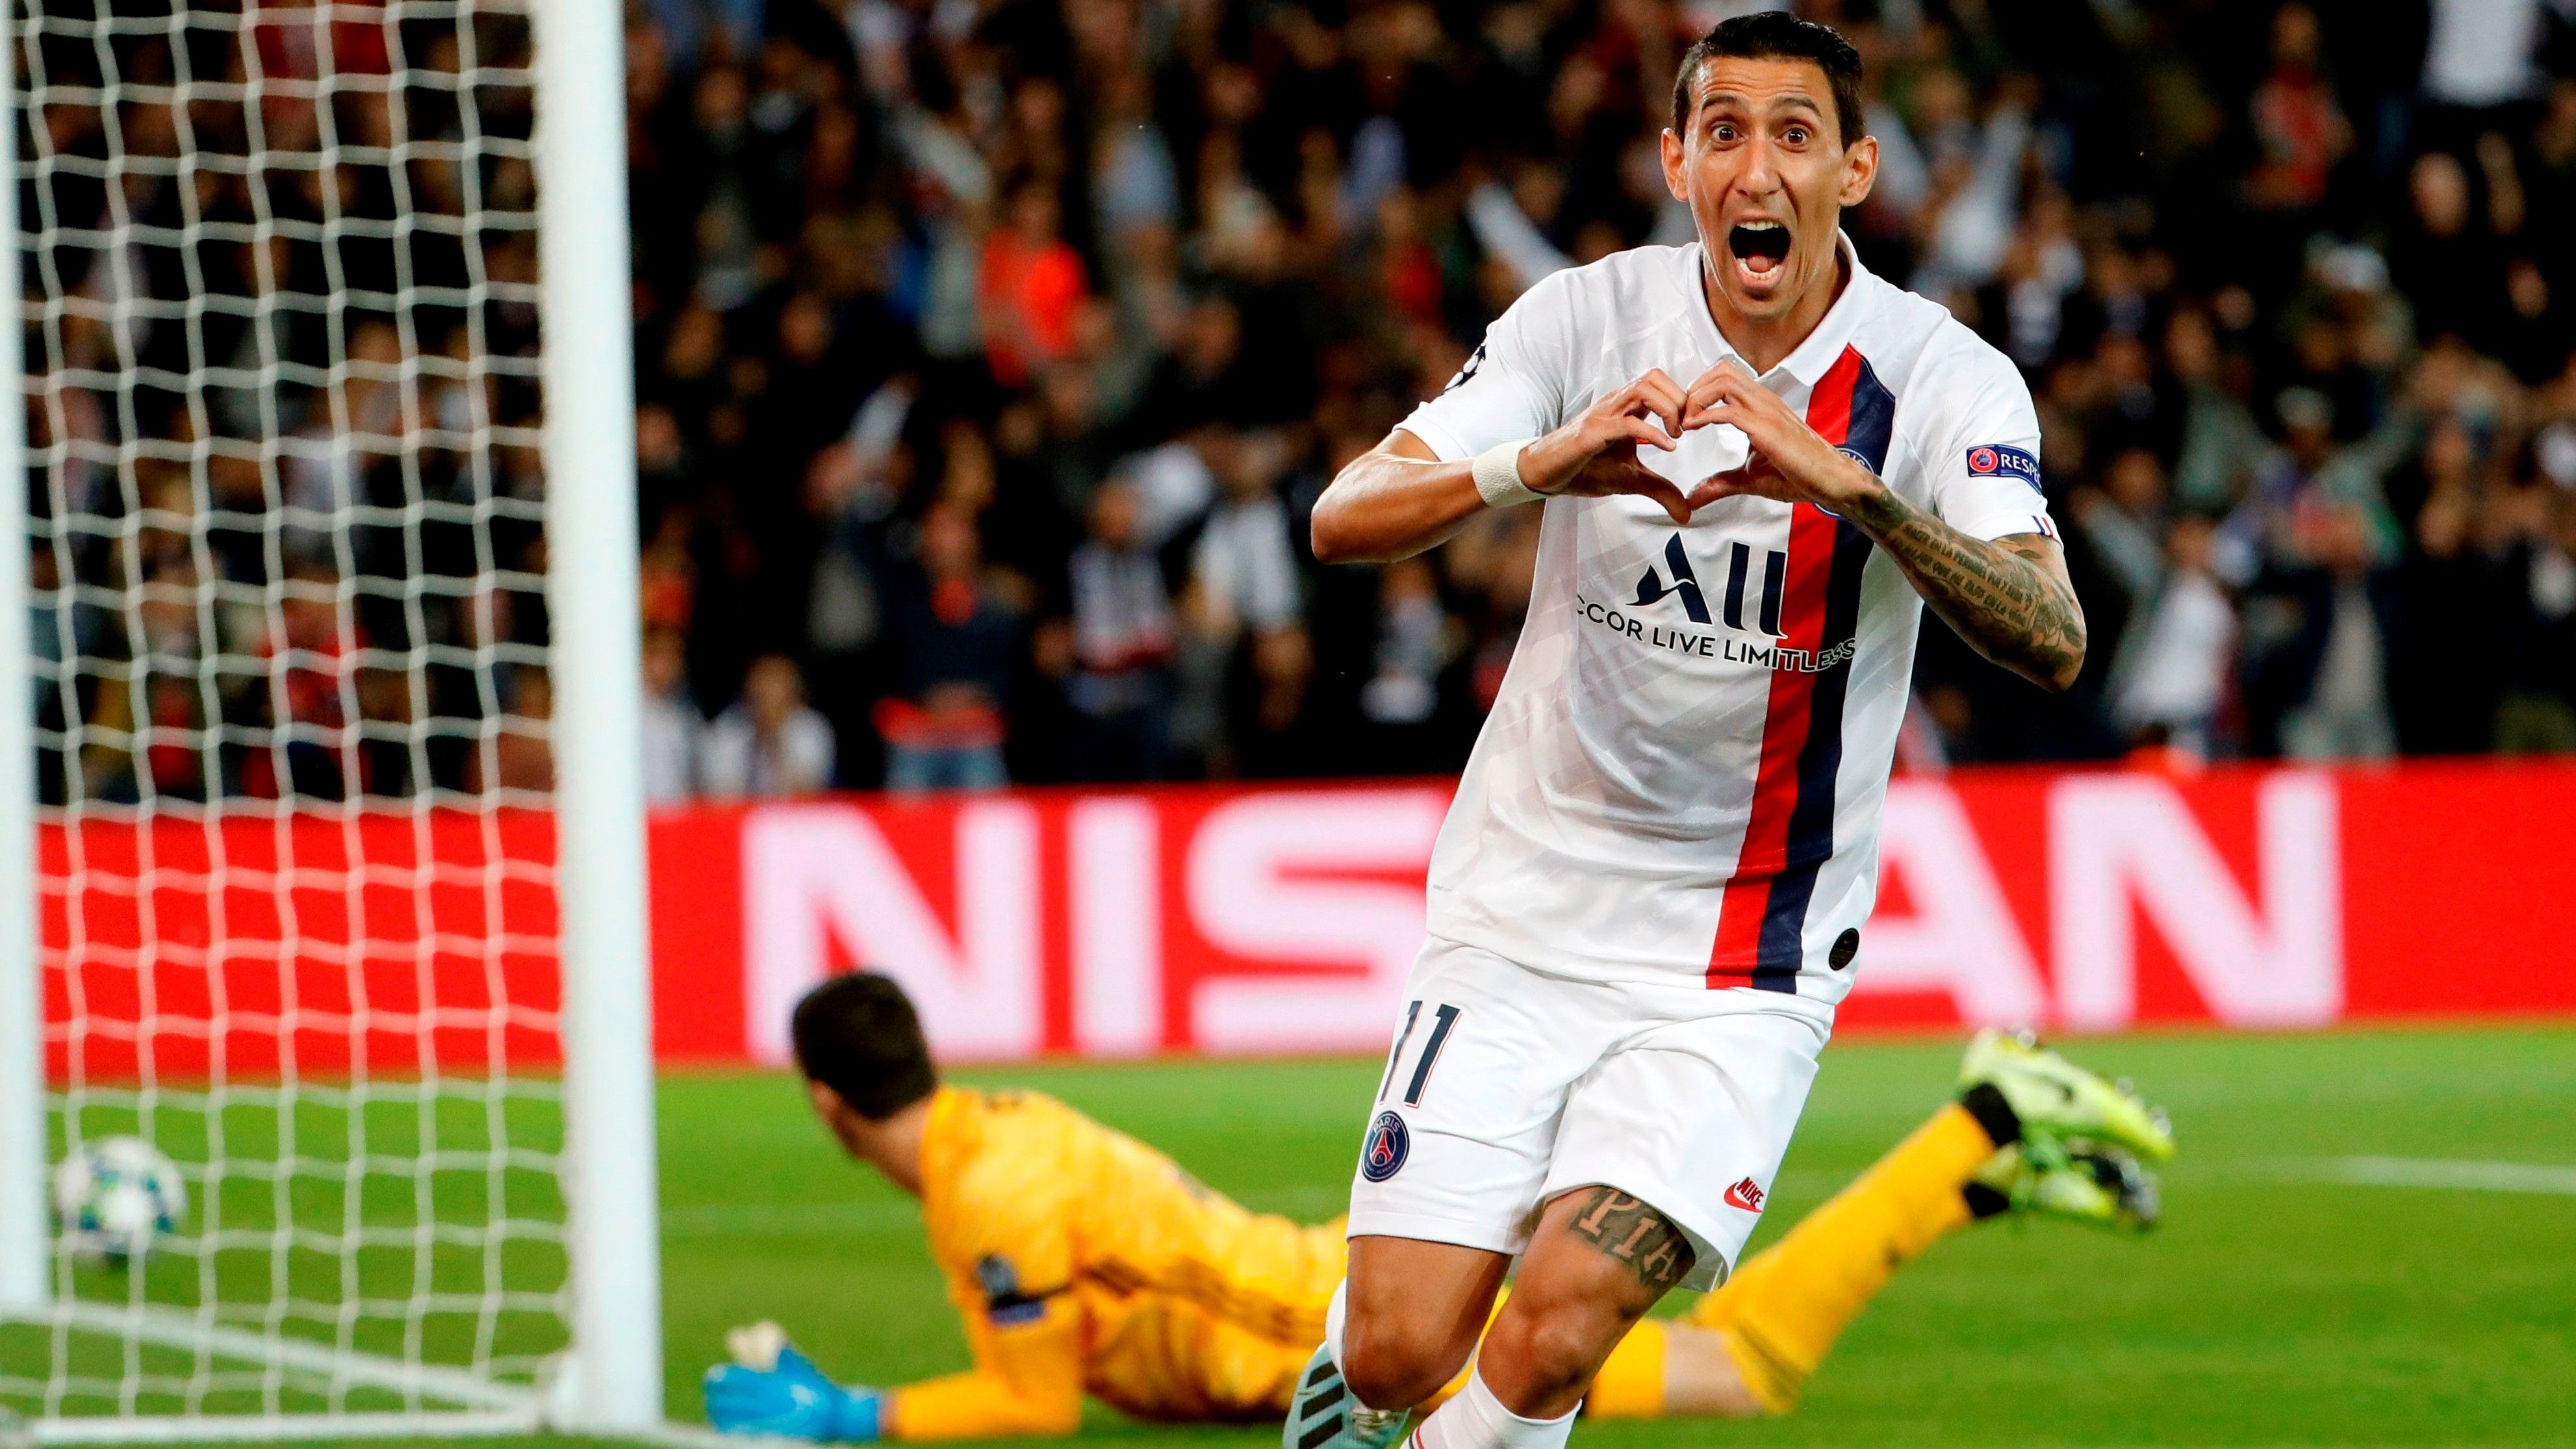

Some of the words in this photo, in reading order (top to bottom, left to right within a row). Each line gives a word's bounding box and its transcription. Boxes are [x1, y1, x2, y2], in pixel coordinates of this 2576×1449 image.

[1652, 626, 1715, 658] LIVE
[1723, 637, 1857, 673] LIMITLESS
[741, 770, 2342, 1064] NISAN
[1379, 1000, 1462, 1109] 11
[1373, 1116, 1401, 1134] PARIS
[1737, 1176, 1765, 1210] NIKE
[1577, 1188, 1681, 1282] PIA
